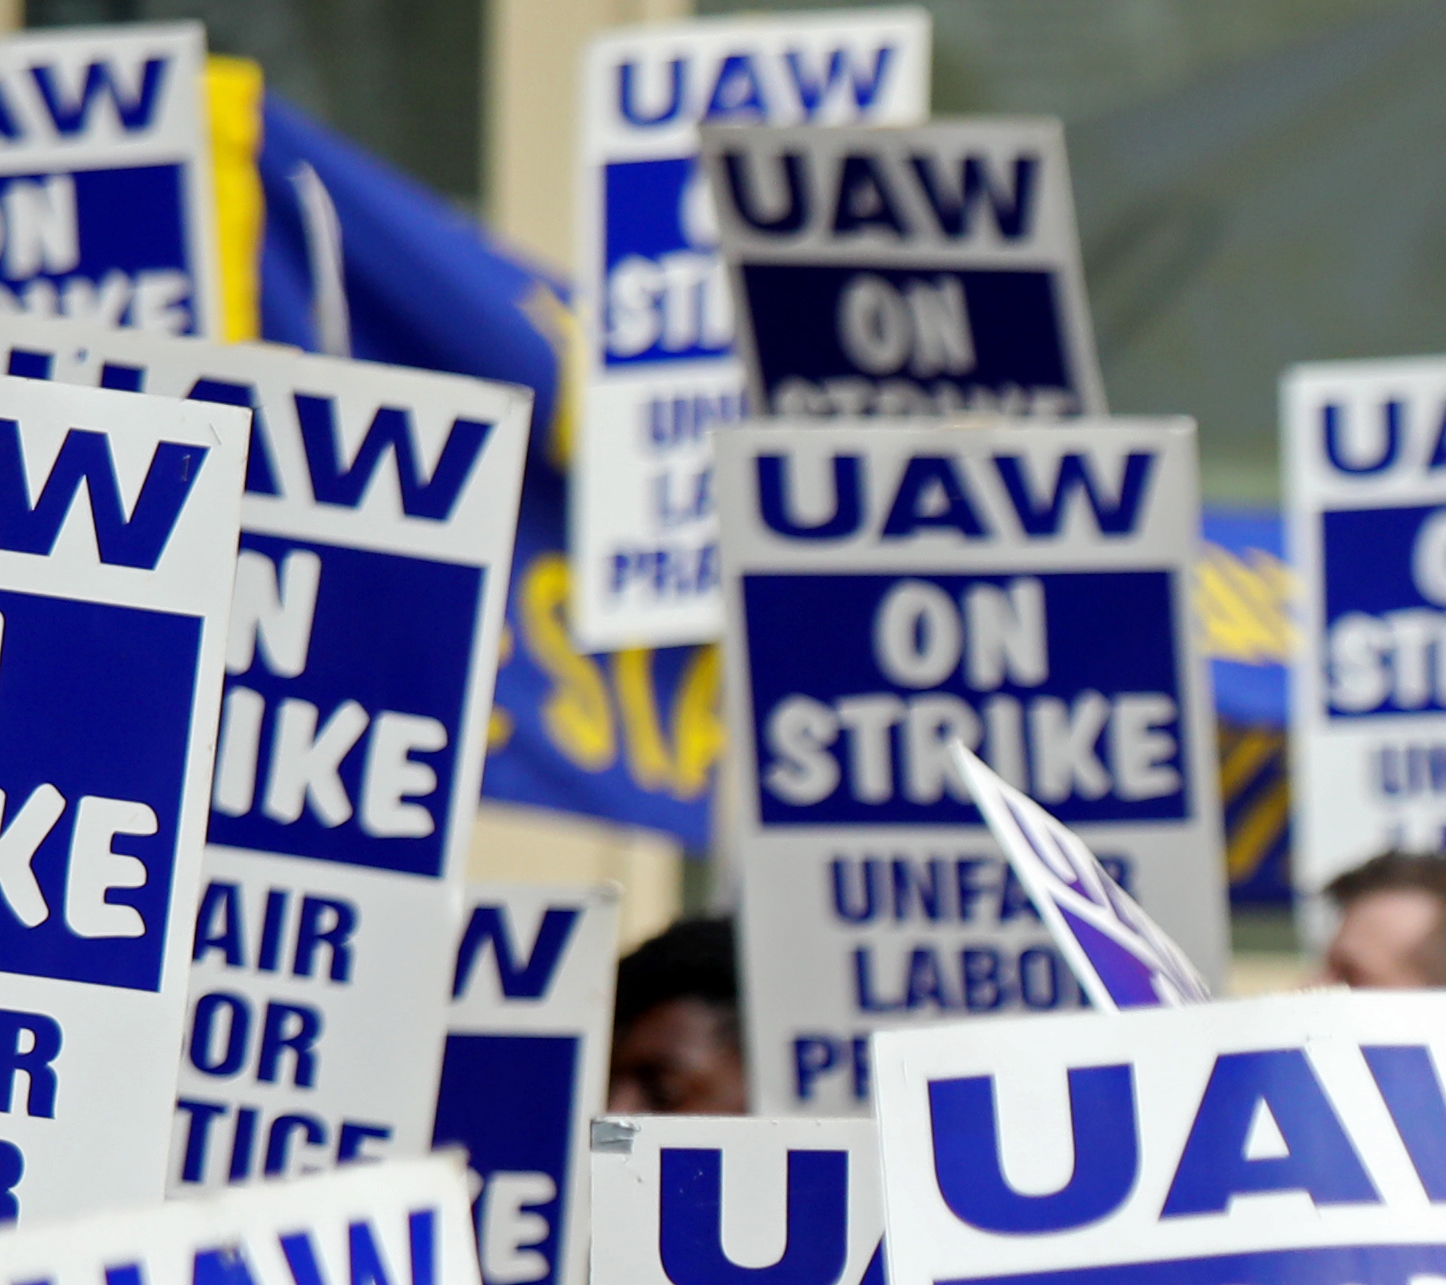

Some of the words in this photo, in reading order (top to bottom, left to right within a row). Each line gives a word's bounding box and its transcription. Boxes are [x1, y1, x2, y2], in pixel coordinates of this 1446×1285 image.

[616, 46, 892, 130] UAW
[0, 175, 78, 278] N
[722, 150, 1040, 242] UAW
[838, 274, 976, 378] ON
[754, 450, 1156, 542] UAW
[228, 546, 322, 680] N
[872, 574, 1050, 690] ON
[212, 688, 448, 838] IKE
[764, 690, 1180, 806] STRIKE
[194, 878, 362, 985] AIR
[850, 943, 1090, 1015] LABO
[178, 1096, 394, 1186] TICE
